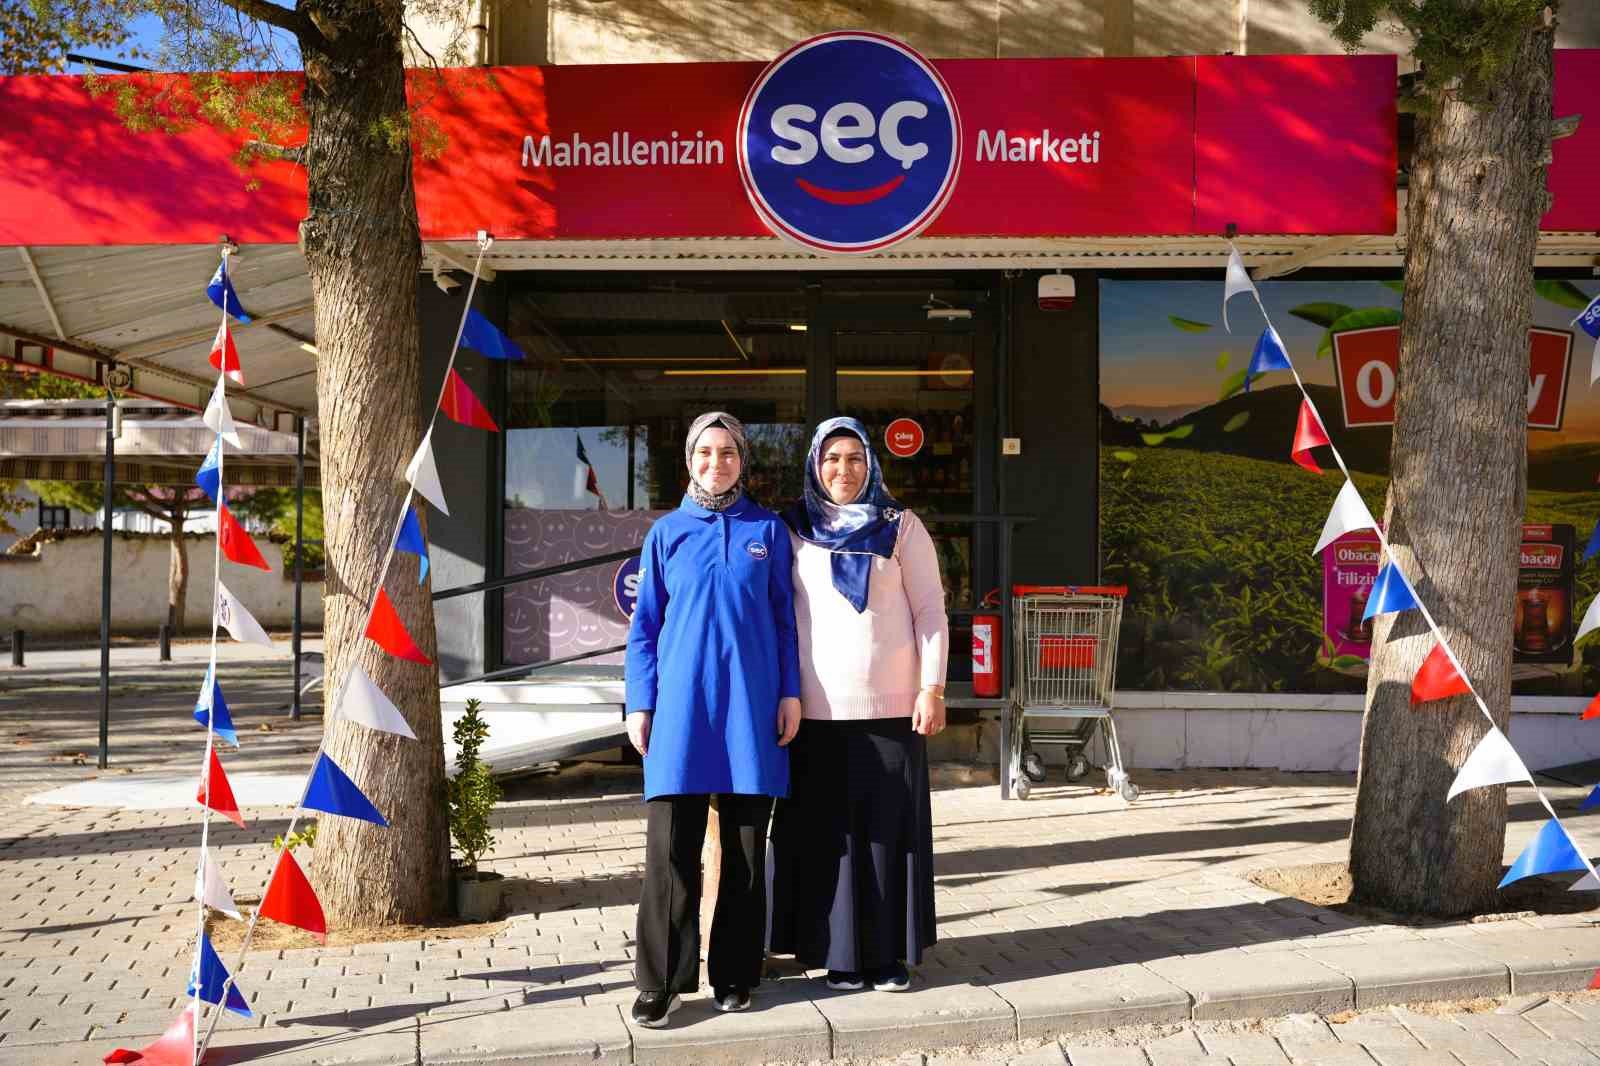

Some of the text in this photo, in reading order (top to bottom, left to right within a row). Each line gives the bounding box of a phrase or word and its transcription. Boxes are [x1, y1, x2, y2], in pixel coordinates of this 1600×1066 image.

[521, 100, 1101, 170] Mahallenizin seç Marketi
[1585, 304, 1600, 325] se
